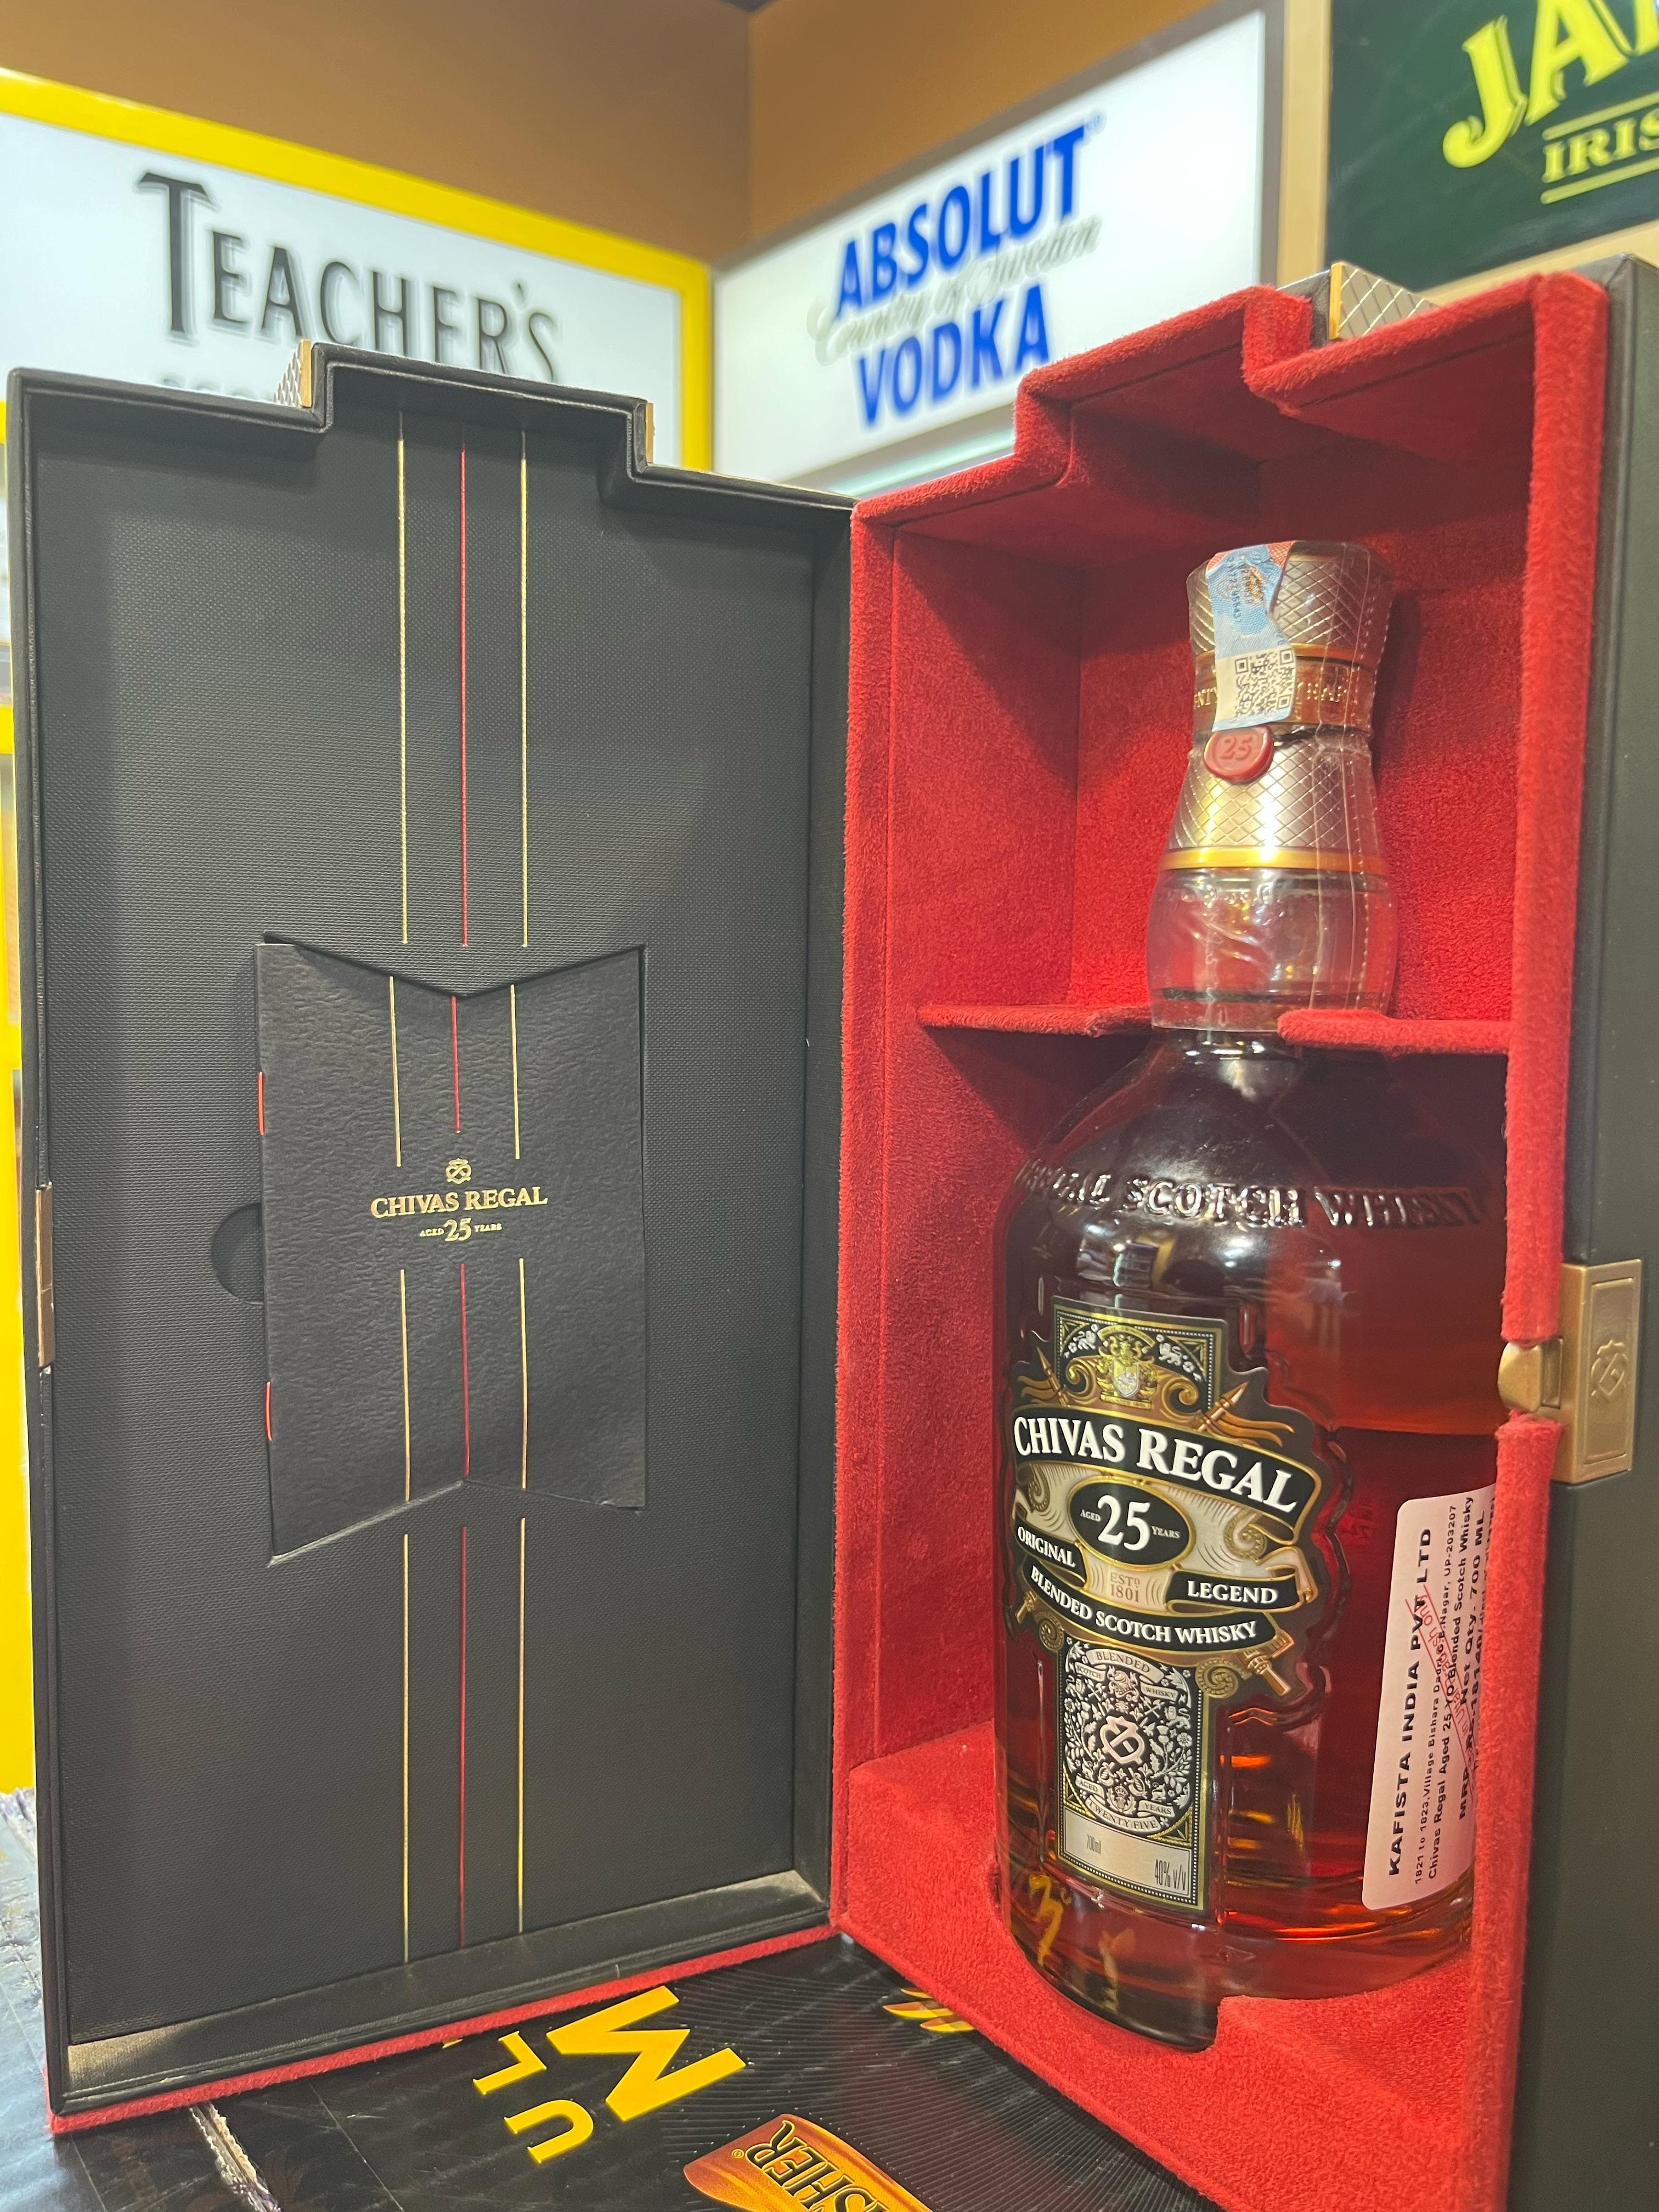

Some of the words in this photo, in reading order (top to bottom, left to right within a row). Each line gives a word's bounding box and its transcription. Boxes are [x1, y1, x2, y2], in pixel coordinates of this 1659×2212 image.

[837, 125, 1085, 318] ABSOLUT
[857, 284, 1049, 426] VODKA
[1219, 736, 1252, 761] 25
[370, 1191, 460, 1218] CHIVAS
[464, 1186, 549, 1210] REGAL
[419, 1227, 444, 1238] AGED
[444, 1217, 472, 1242] 25
[473, 1223, 503, 1233] YEARS
[1014, 1416, 1125, 1463] CHIVAS
[1136, 1427, 1297, 1513] REGAL
[1080, 1508, 1101, 1522] AGED
[1097, 1494, 1151, 1551] 25
[1152, 1526, 1180, 1539] YEARS
[1443, 1505, 1455, 1576] UP-203207
[1459, 1497, 1473, 1553] Whisky
[1017, 1526, 1076, 1568] ORIGINAL
[1417, 1529, 1431, 1583] LTD
[1030, 1565, 1092, 1621] BLENDED
[1095, 1609, 1173, 1643] SCOTCH
[1174, 1621, 1258, 1644] WHISKY
[1187, 1580, 1278, 1604] LEGEND
[1454, 1558, 1466, 1611] Scotch
[1410, 1595, 1425, 1650] PVT
[1460, 1662, 1470, 1705] Net
[1470, 1555, 1480, 1599] 700
[1475, 1510, 1484, 1545] ML
[1096, 1651, 1150, 1673] BLENDED
[1448, 1617, 1461, 1678] Blended
[1076, 1665, 1101, 1679] SCOTCH
[1146, 1686, 1176, 1699] WHISKY
[1402, 1661, 1419, 1741] INDIA
[1428, 1698, 1439, 1746] Bishara
[1442, 1713, 1451, 1731] 25
[1438, 1737, 1450, 1774] Aged
[1079, 1781, 1098, 1792] AGED
[1434, 1781, 1446, 1823] Regal
[1087, 1800, 1131, 1827] TWENTY
[1133, 1819, 1158, 1830] FIVE
[1144, 1803, 1172, 1814] YEARS
[1389, 1752, 1410, 1875] KAFISTA
[1086, 1834, 1101, 1854] 700ml
[1418, 1837, 1425, 1849] to
[1429, 1829, 1441, 1878] Chivas
[1154, 1859, 1170, 1888] 40%
[1173, 1865, 1186, 1891] v/v
[1415, 1855, 1424, 1884] 1821
